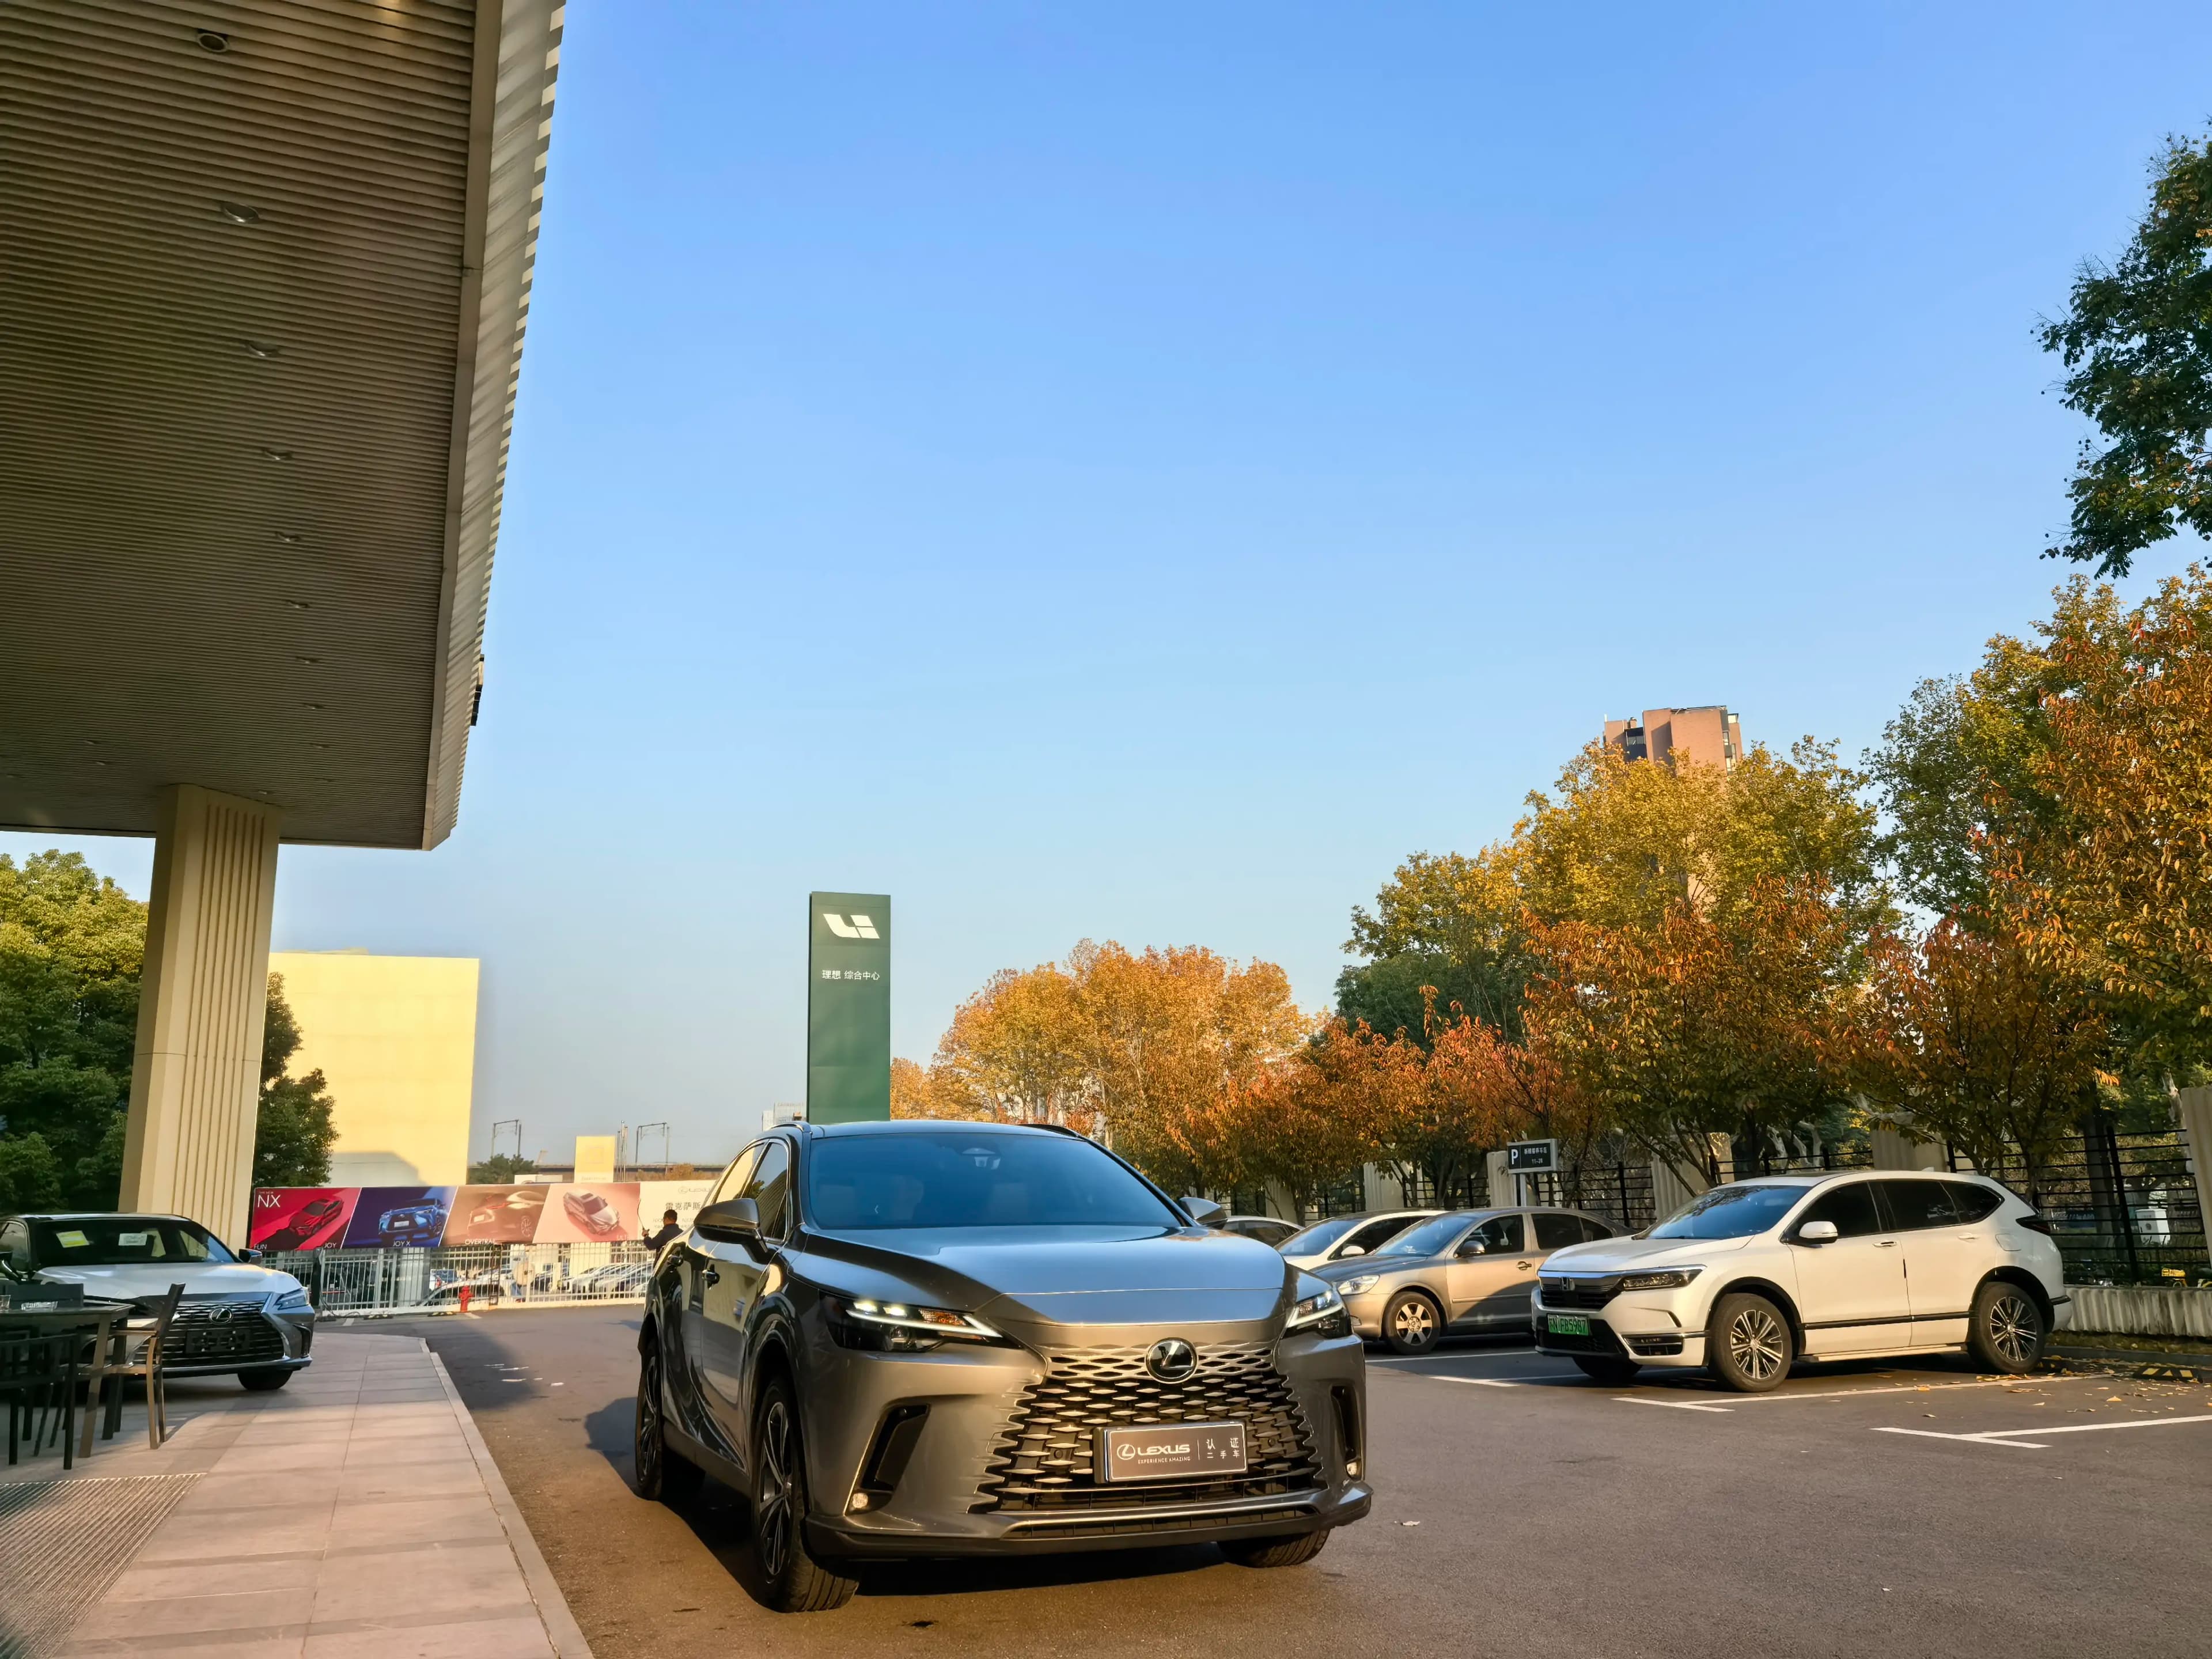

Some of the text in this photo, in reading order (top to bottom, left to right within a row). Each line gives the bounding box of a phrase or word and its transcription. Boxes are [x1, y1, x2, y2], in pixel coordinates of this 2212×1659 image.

[821, 969, 880, 980] 理想 综合中心
[1511, 1149, 1518, 1165] P
[257, 1194, 281, 1208] NX
[665, 1202, 701, 1211] 雷克萨斯
[1137, 1444, 1191, 1456] LEXUS
